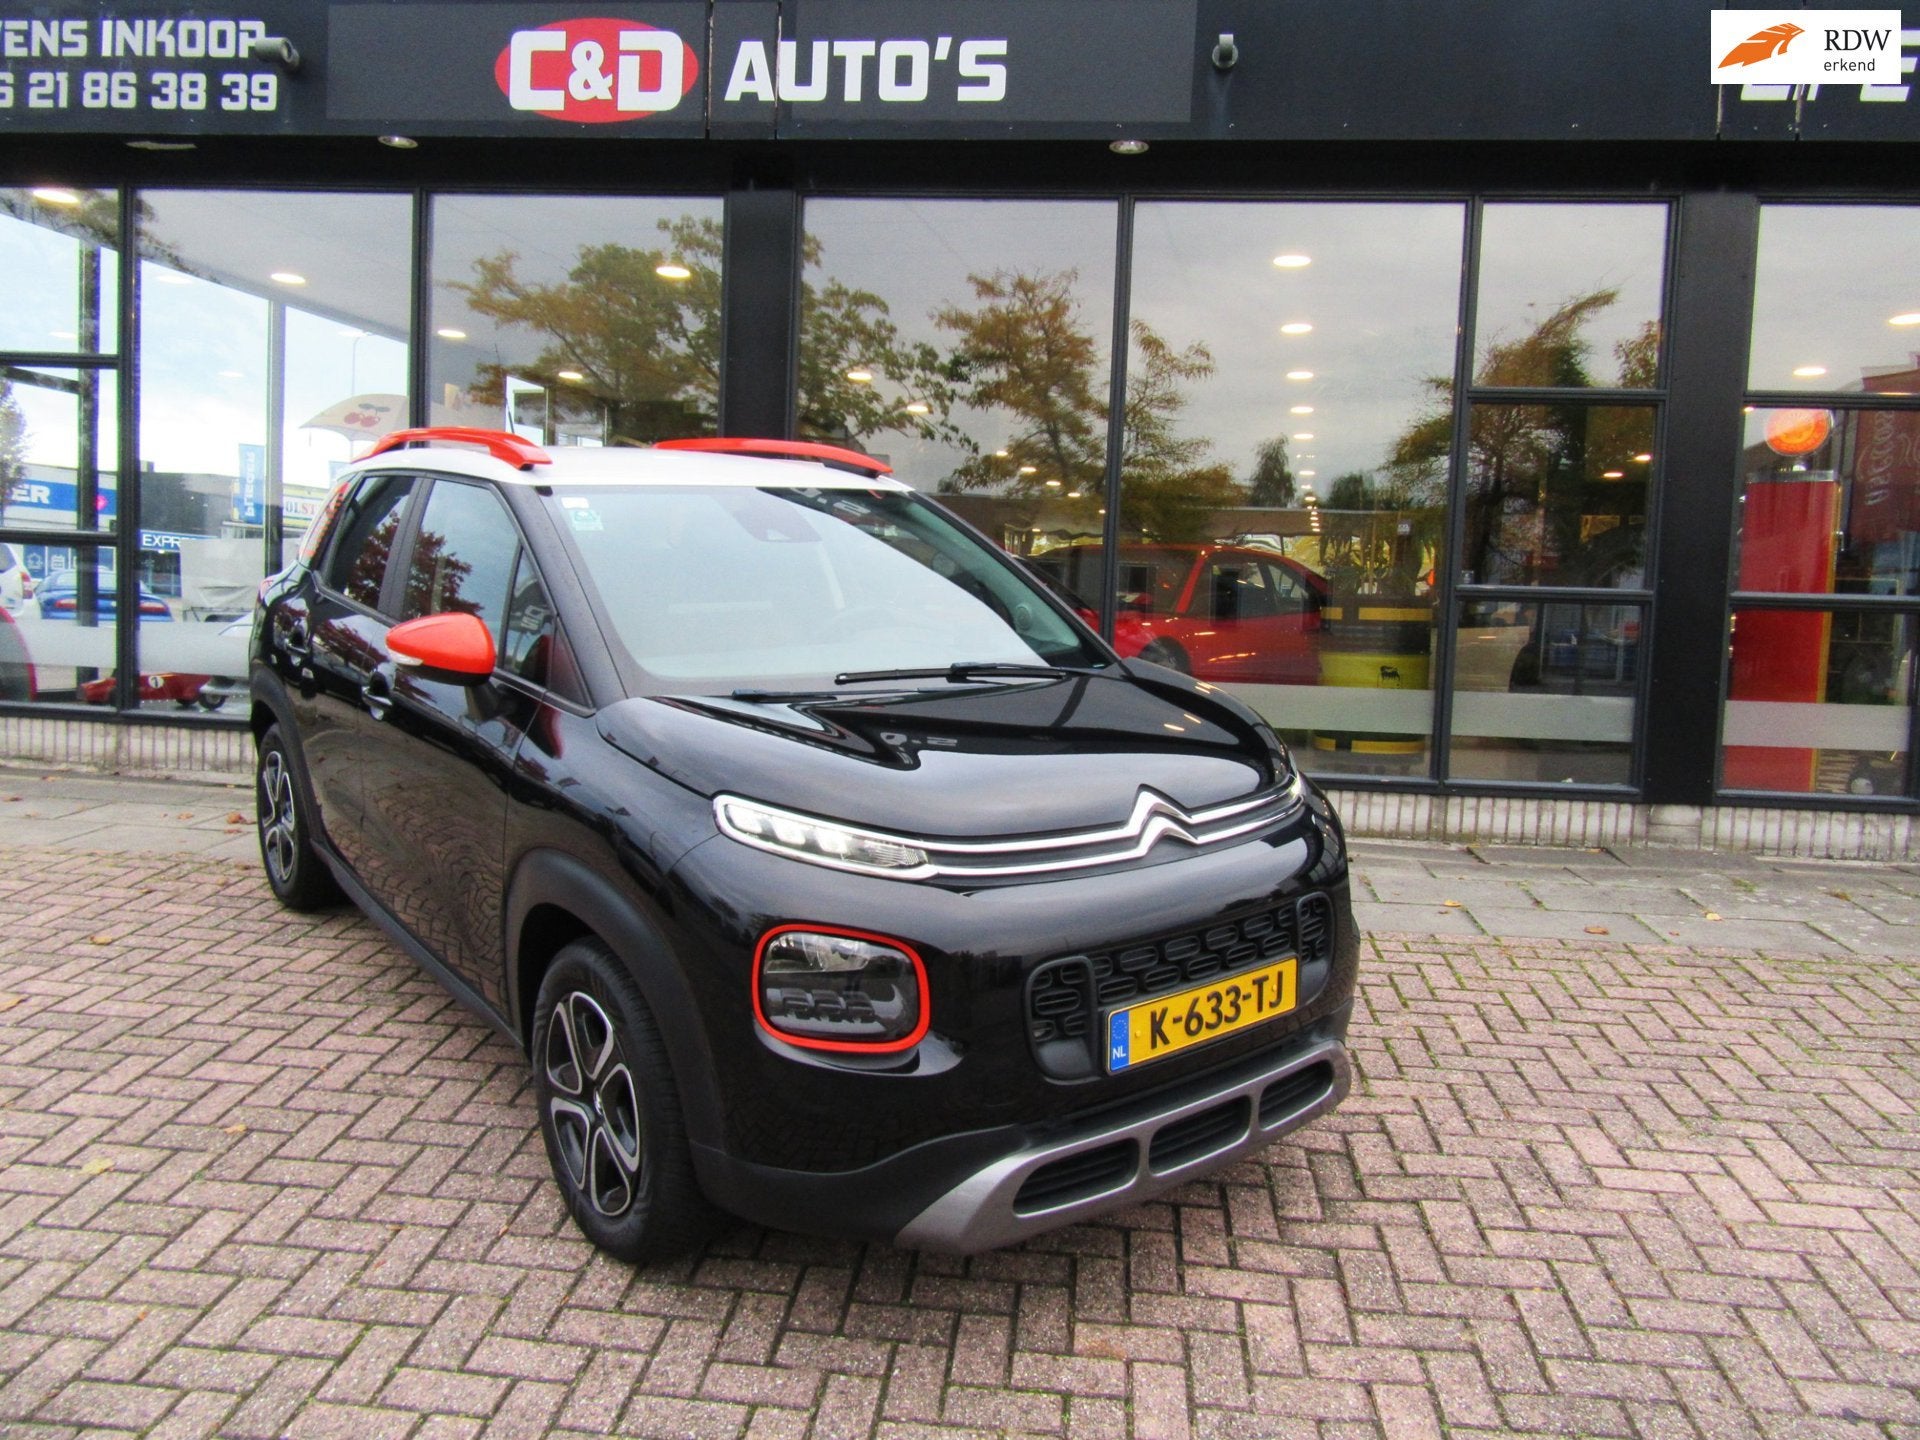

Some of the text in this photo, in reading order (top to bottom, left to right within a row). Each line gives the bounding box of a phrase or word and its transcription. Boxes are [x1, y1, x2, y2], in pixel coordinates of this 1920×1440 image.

[0, 20, 265, 57] ENS INKOOP
[509, 30, 1008, 112] C&D AUTO'S
[28, 72, 68, 108] 21
[82, 72, 137, 108] 86
[151, 72, 207, 110] 38
[221, 73, 277, 111] 39
[1149, 970, 1284, 1050] K-633-TJ
[1112, 1046, 1127, 1061] NL
